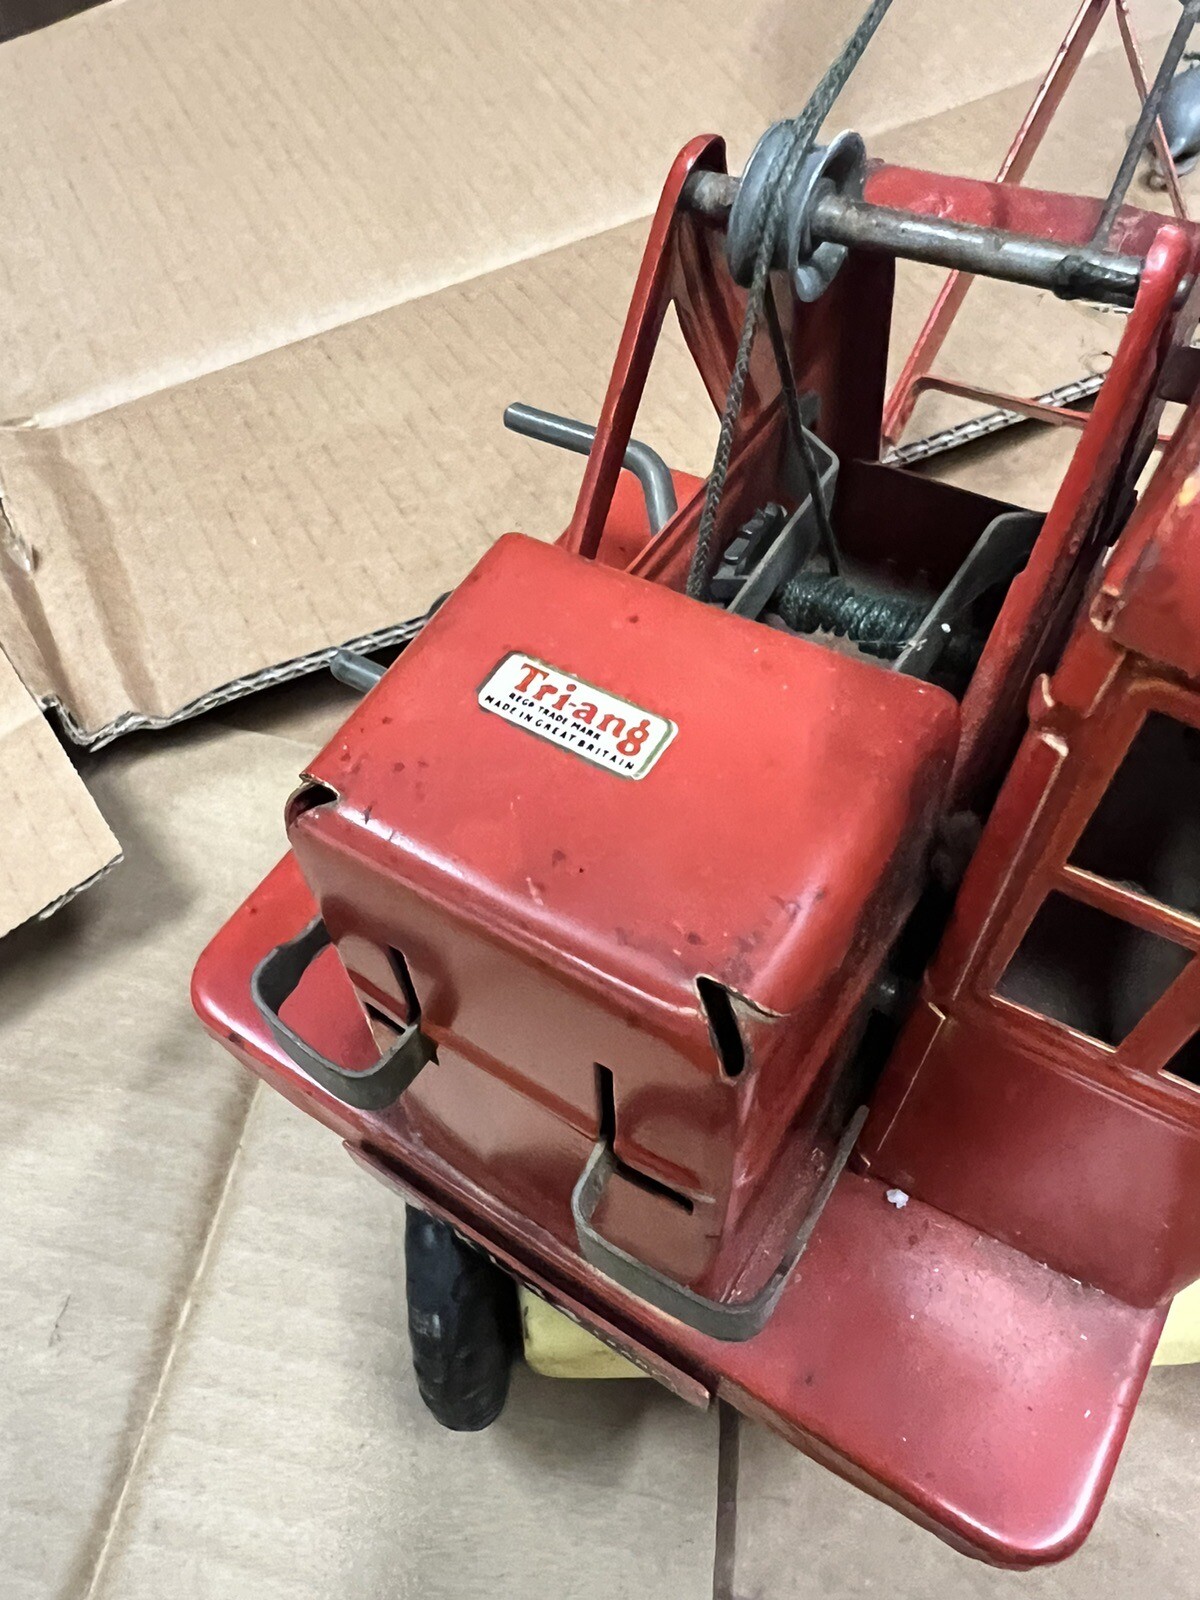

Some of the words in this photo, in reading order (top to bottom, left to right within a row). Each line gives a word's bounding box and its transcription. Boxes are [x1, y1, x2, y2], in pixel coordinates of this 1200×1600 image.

[485, 695, 517, 715] MADE
[519, 711, 533, 722] IN
[535, 719, 577, 741] GREAT
[577, 740, 635, 770] BRITAIN
[514, 663, 651, 756] Tri-ang
[539, 706, 568, 725] TRADE
[571, 722, 601, 740] MARK
